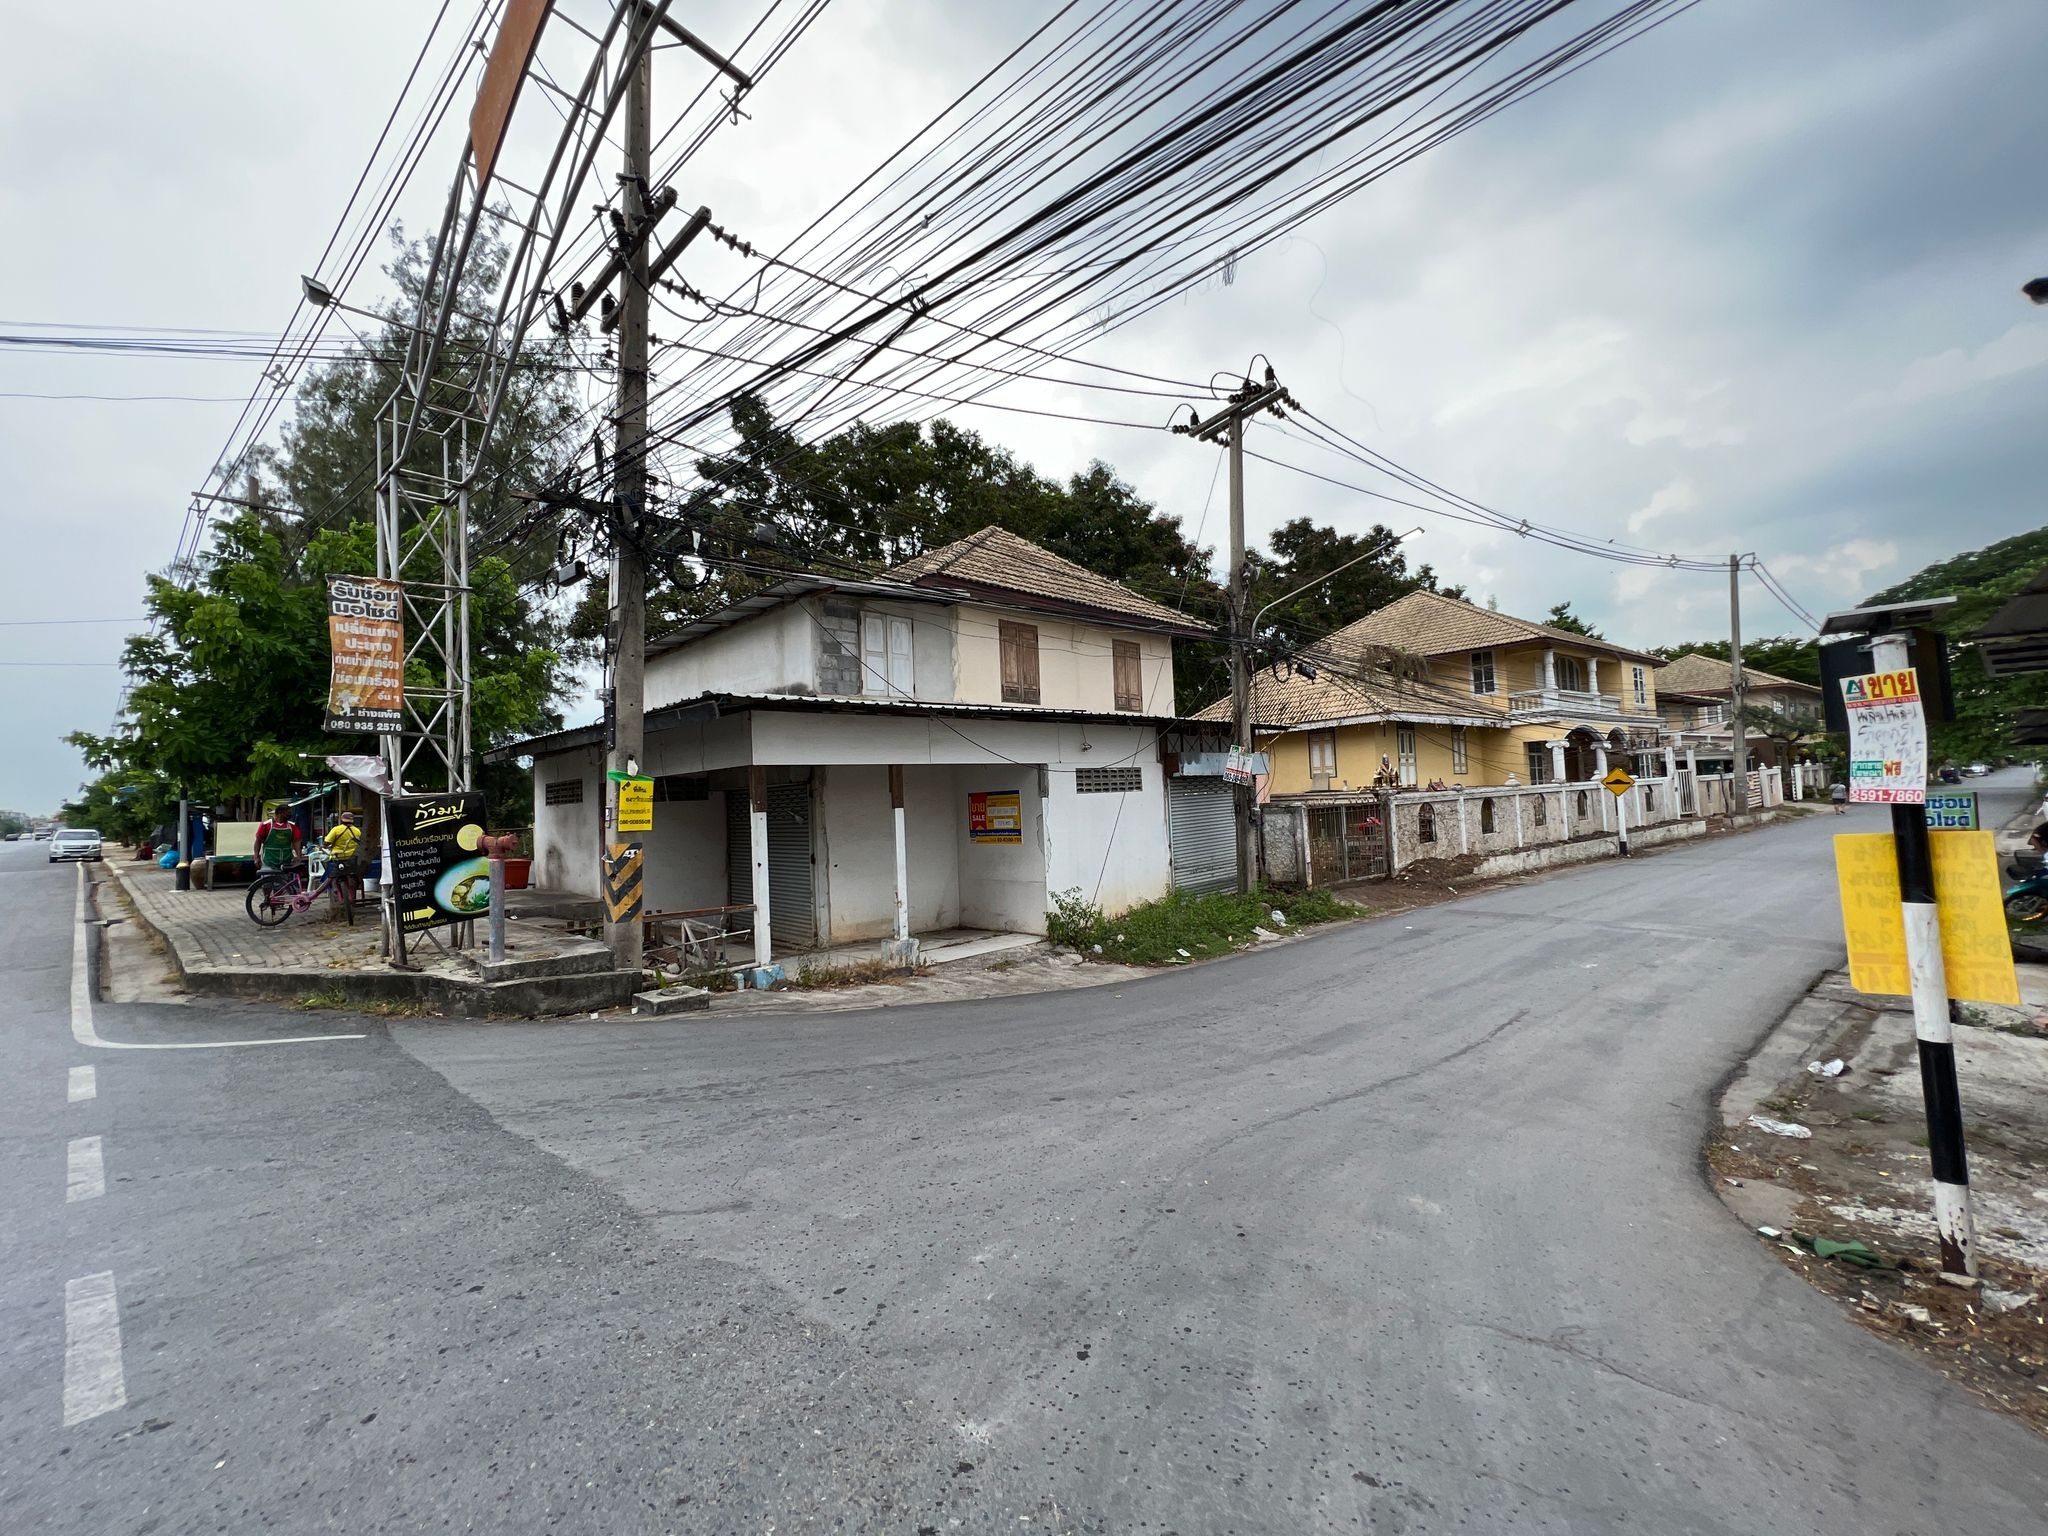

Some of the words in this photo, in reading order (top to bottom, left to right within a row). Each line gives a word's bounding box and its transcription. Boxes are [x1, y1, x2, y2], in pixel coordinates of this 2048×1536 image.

[332, 580, 399, 602] รับซ่อม
[333, 600, 398, 620] มอไซด์
[335, 620, 398, 638] เปลี่ยนยาง
[345, 638, 392, 652] ปะยาง
[335, 671, 400, 688] ซ่อมเครื่อง
[1868, 671, 1916, 698] ขาย
[354, 722, 374, 730] 935
[376, 722, 402, 732] 2576
[1884, 760, 1902, 776] ฟรี
[1861, 790, 1923, 802] 591-7860
[414, 799, 465, 819] ก้ามปู
[1926, 811, 1970, 827] อไซด์
